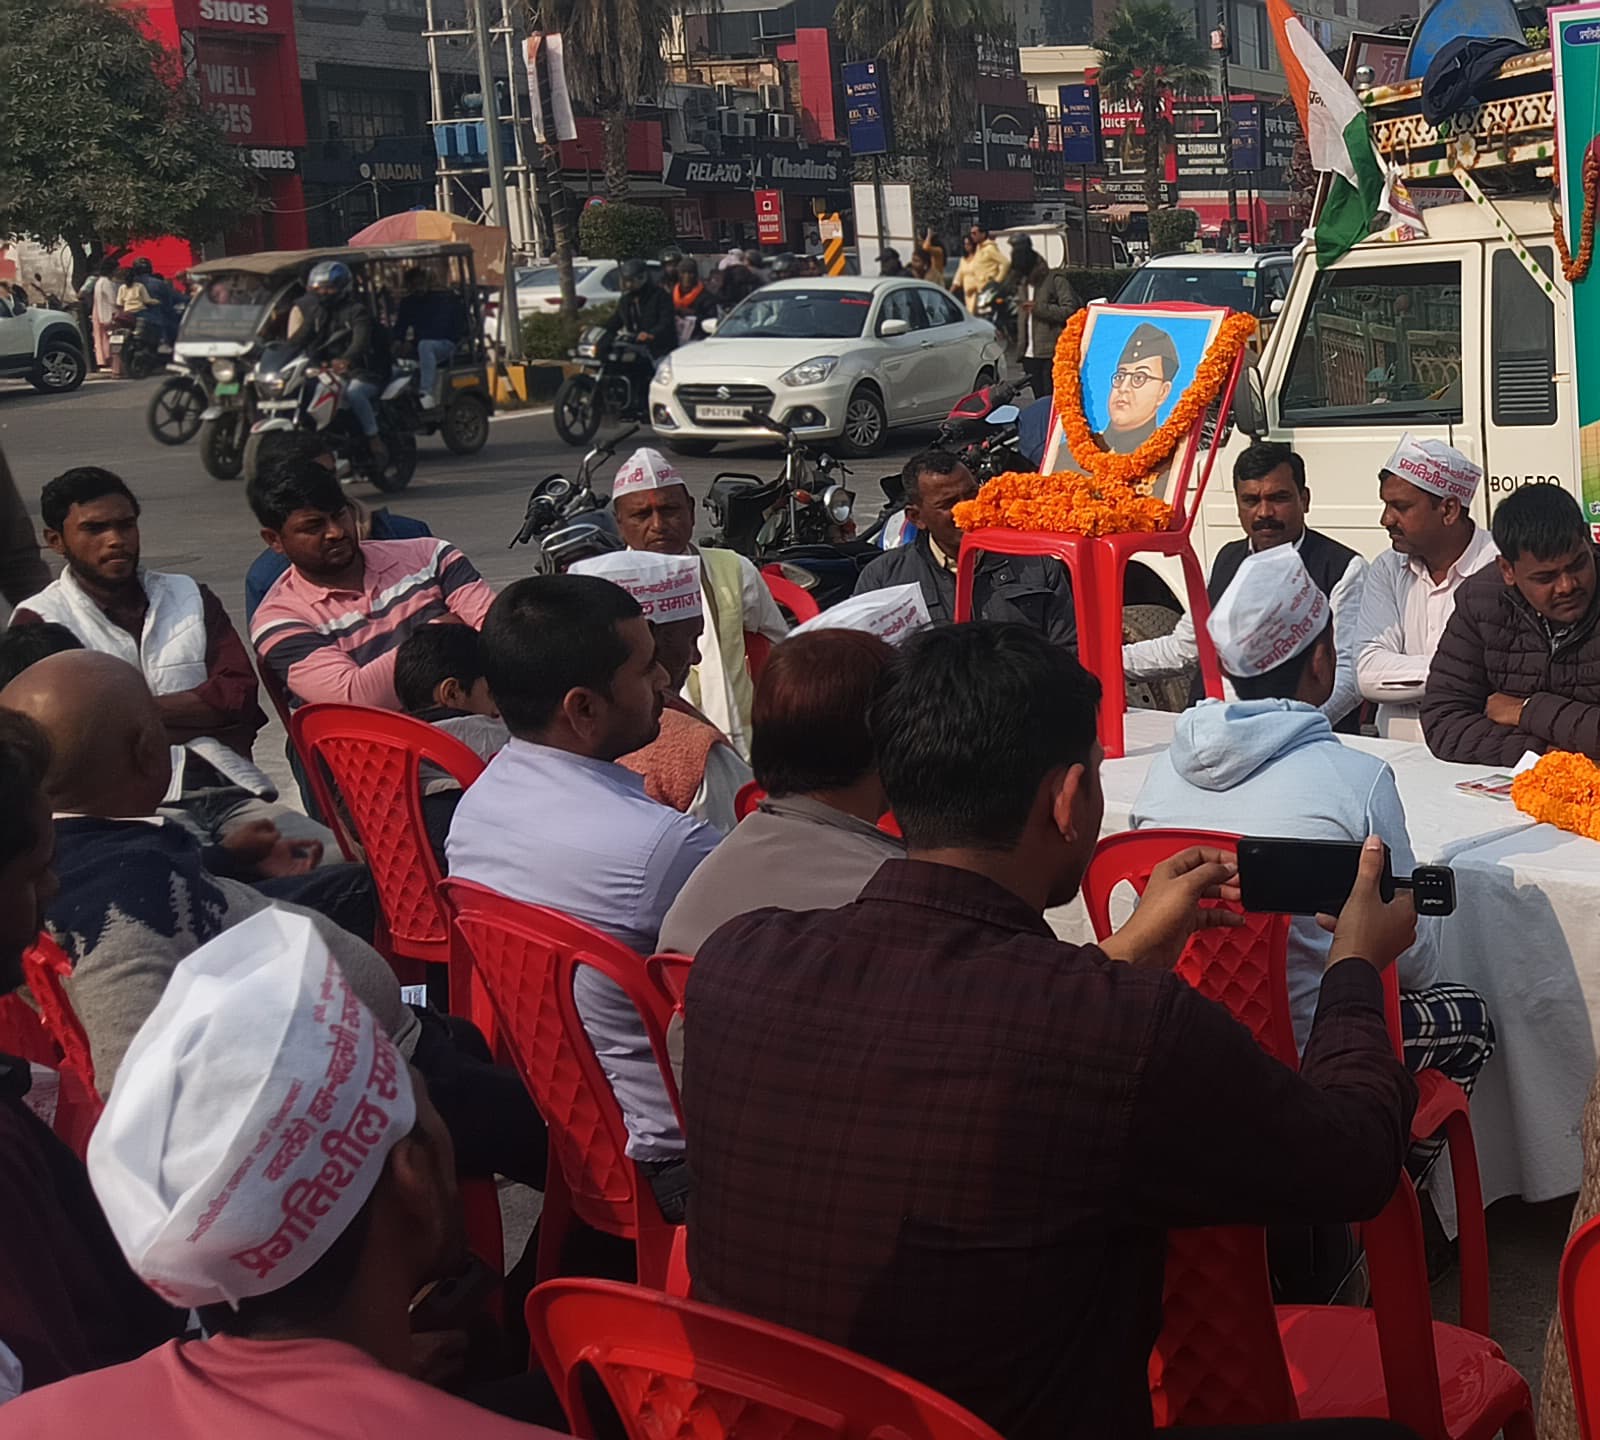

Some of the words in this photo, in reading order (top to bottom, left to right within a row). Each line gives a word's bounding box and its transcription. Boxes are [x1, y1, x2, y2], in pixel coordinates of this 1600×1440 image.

[200, 0, 269, 25] SHOES
[251, 149, 295, 170] SHOES
[772, 157, 837, 180] Khadim's
[686, 162, 742, 183] RELAXO
[1399, 457, 1448, 490] प्रगतिशील
[659, 594, 695, 613] समाज
[228, 1094, 389, 1279] प्रगतिशील
